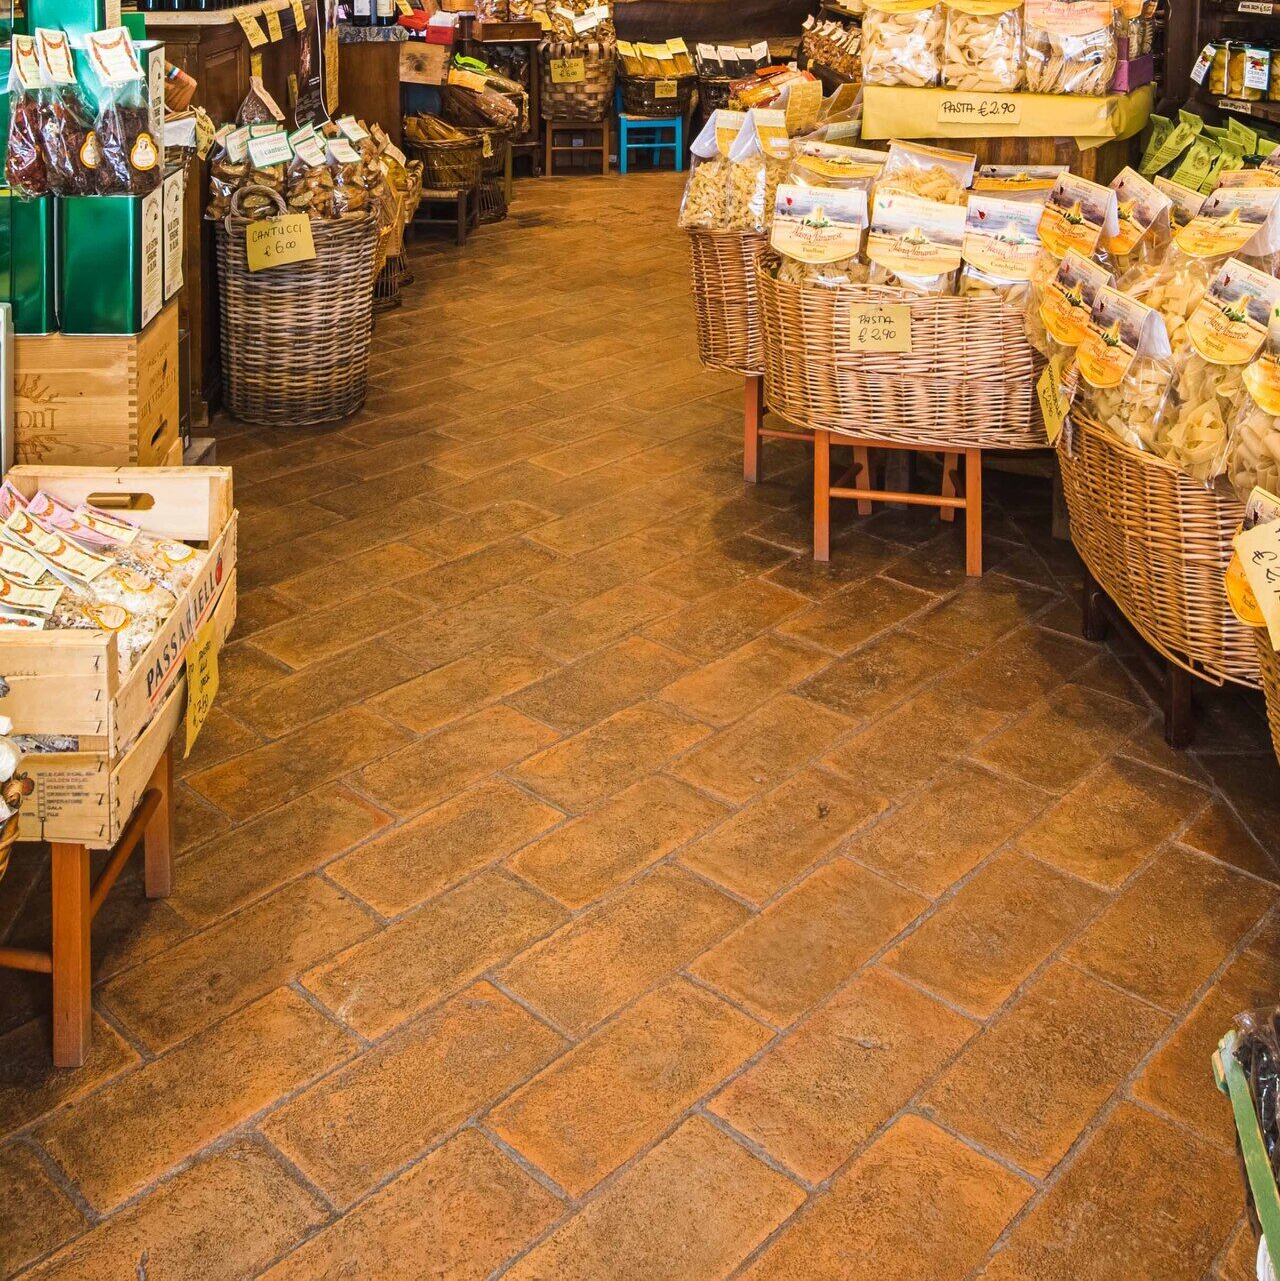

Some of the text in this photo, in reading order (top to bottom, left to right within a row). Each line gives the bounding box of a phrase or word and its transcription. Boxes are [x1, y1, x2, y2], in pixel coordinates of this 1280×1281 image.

[941, 100, 990, 117] PASTA €
[251, 223, 303, 244] CANTUCCI
[263, 245, 271, 258] €
[858, 314, 896, 326] PASTA
[857, 328, 868, 343] €
[1251, 548, 1278, 568] €
